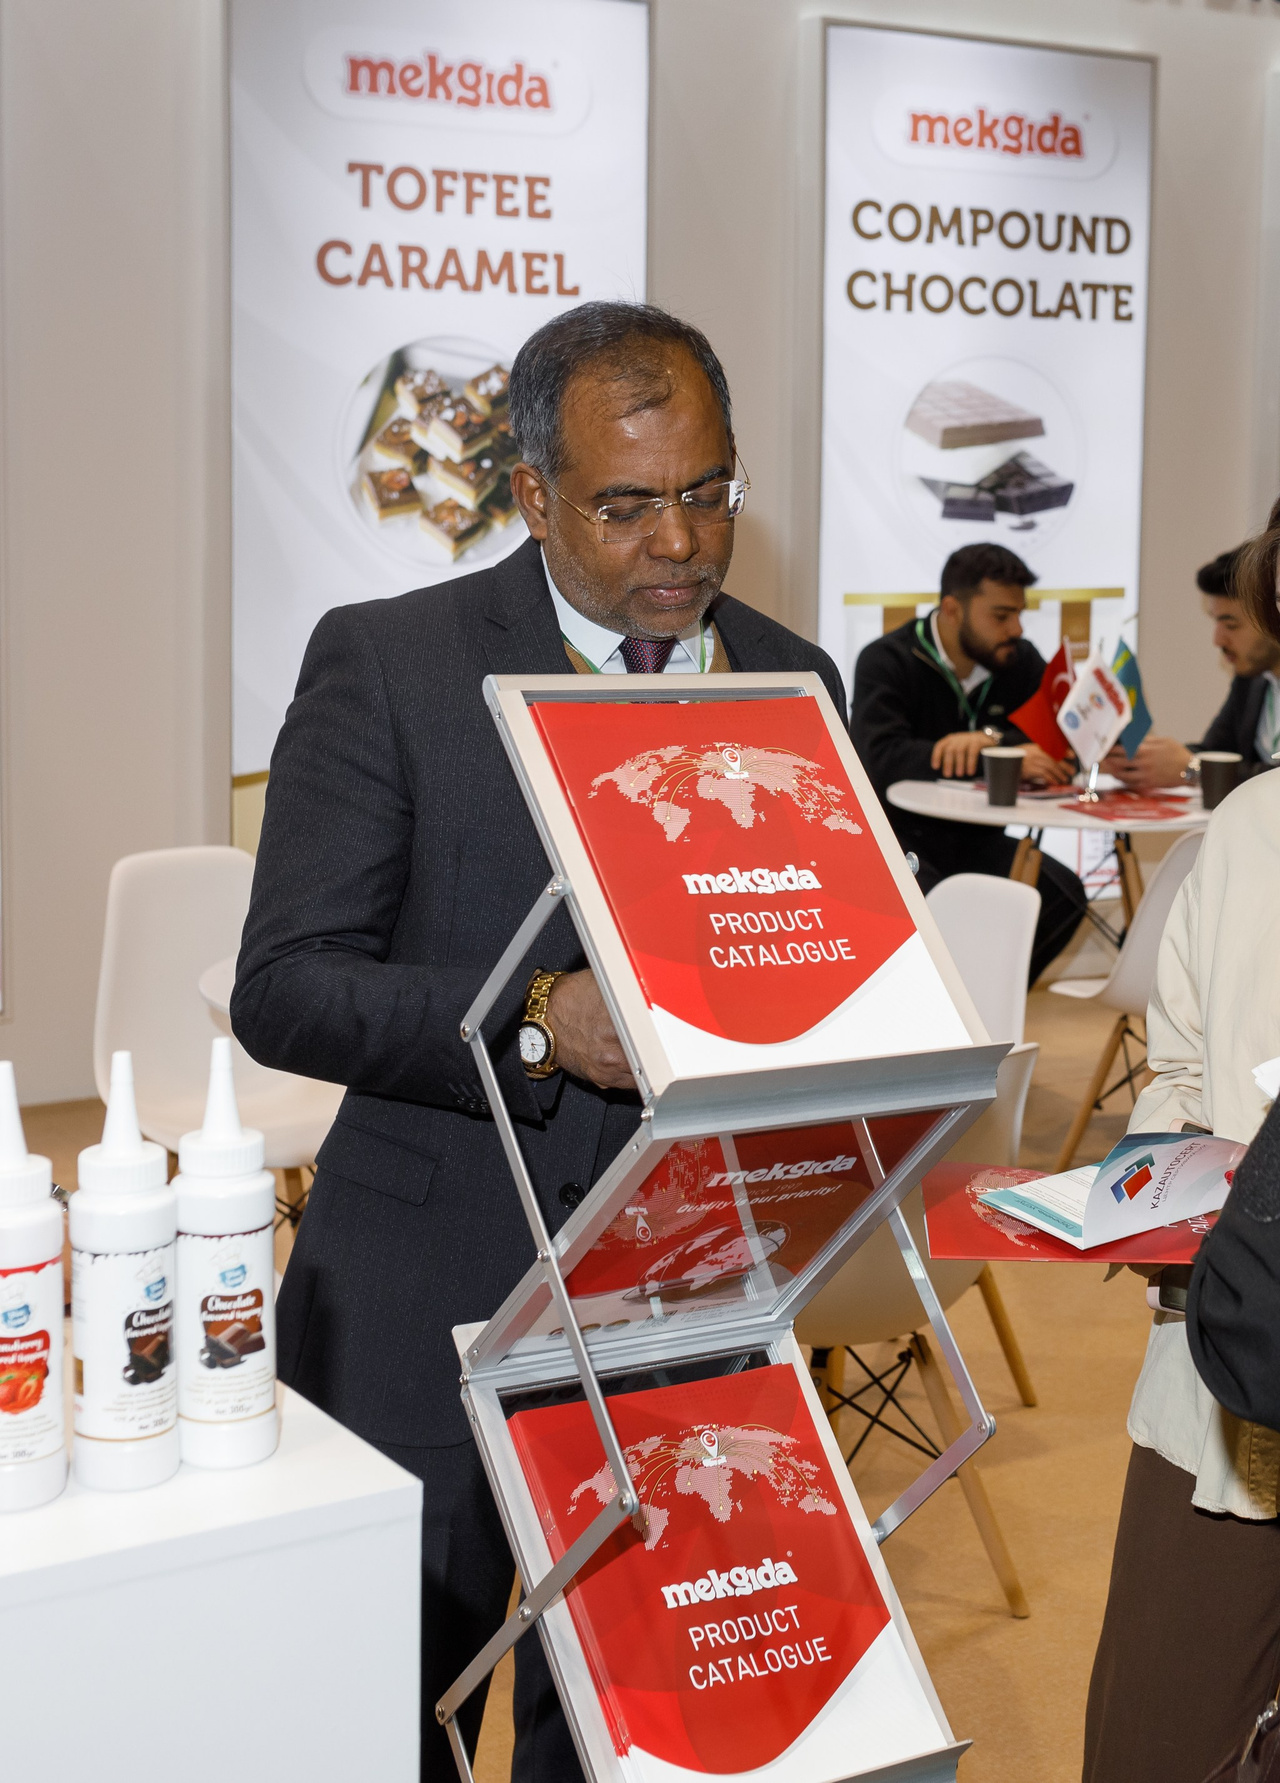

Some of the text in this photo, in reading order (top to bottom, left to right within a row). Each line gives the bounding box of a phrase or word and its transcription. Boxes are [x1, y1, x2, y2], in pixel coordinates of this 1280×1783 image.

[347, 161, 552, 219] TOFFEE
[850, 199, 1132, 256] COMPOUND
[315, 240, 580, 297] CARAMEL
[845, 269, 1135, 322] CHOCOLATE
[708, 908, 824, 935] PRODUCT
[708, 938, 856, 969] CATALOGUE
[676, 1200, 733, 1215] Quality
[749, 1194, 774, 1206] our
[774, 1184, 843, 1203] priority!
[1150, 1142, 1201, 1210] KAZAUTOCERT
[688, 1604, 801, 1652] PRODUCT
[688, 1636, 832, 1690] CATALOGUE
